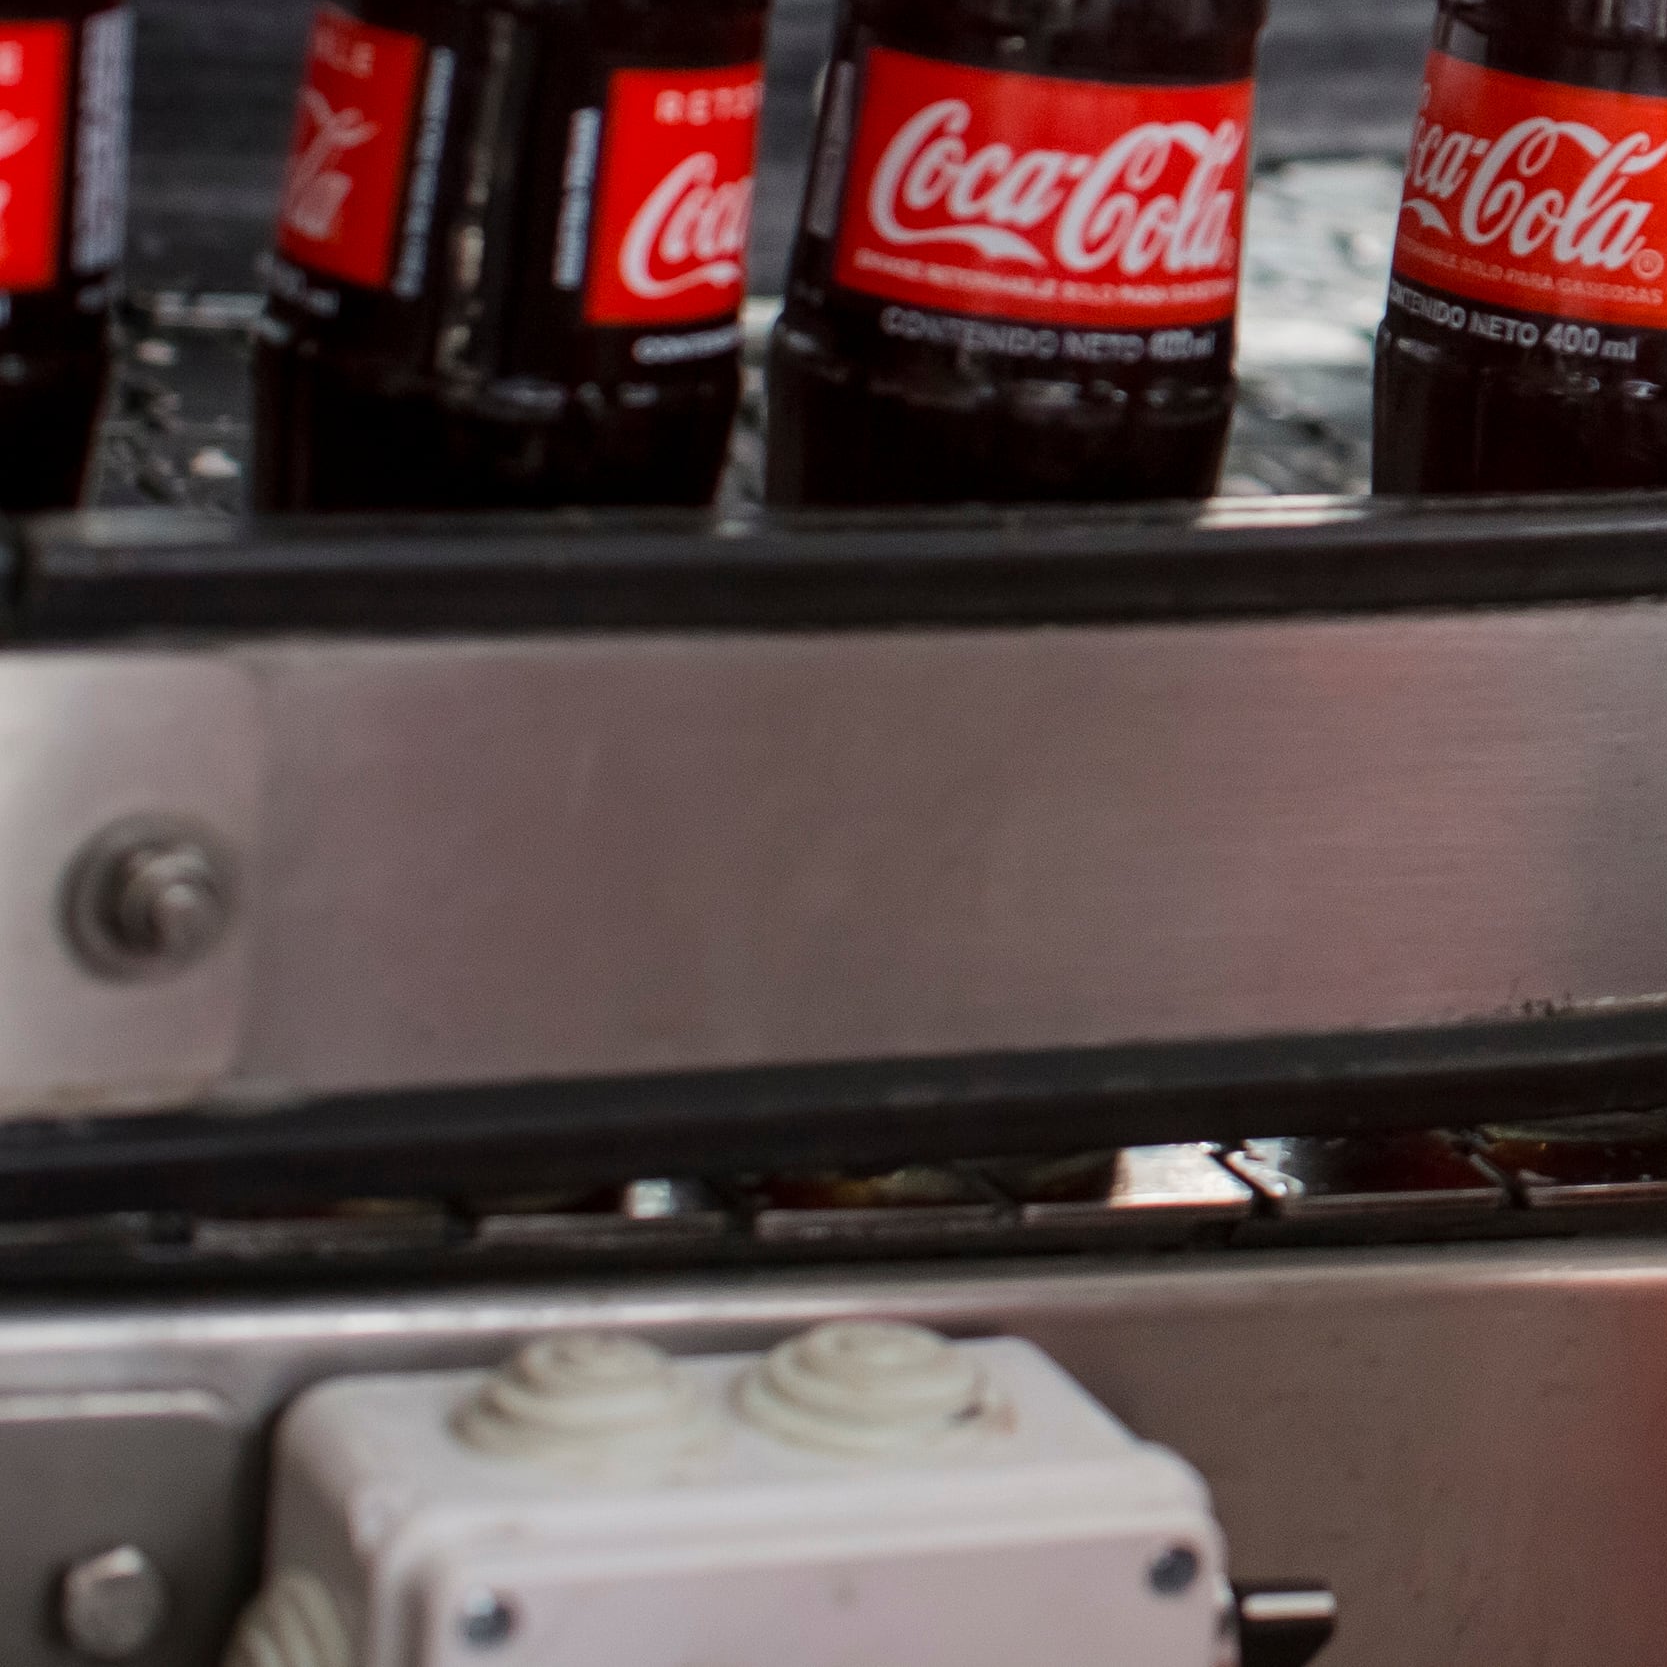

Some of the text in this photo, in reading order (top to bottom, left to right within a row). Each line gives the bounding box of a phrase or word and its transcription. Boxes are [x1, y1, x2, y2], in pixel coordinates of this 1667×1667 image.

[868, 98, 1243, 273] Coca-Cola
[1468, 309, 1541, 348] NETO
[1544, 321, 1602, 357] 400
[1602, 335, 1639, 362] ml
